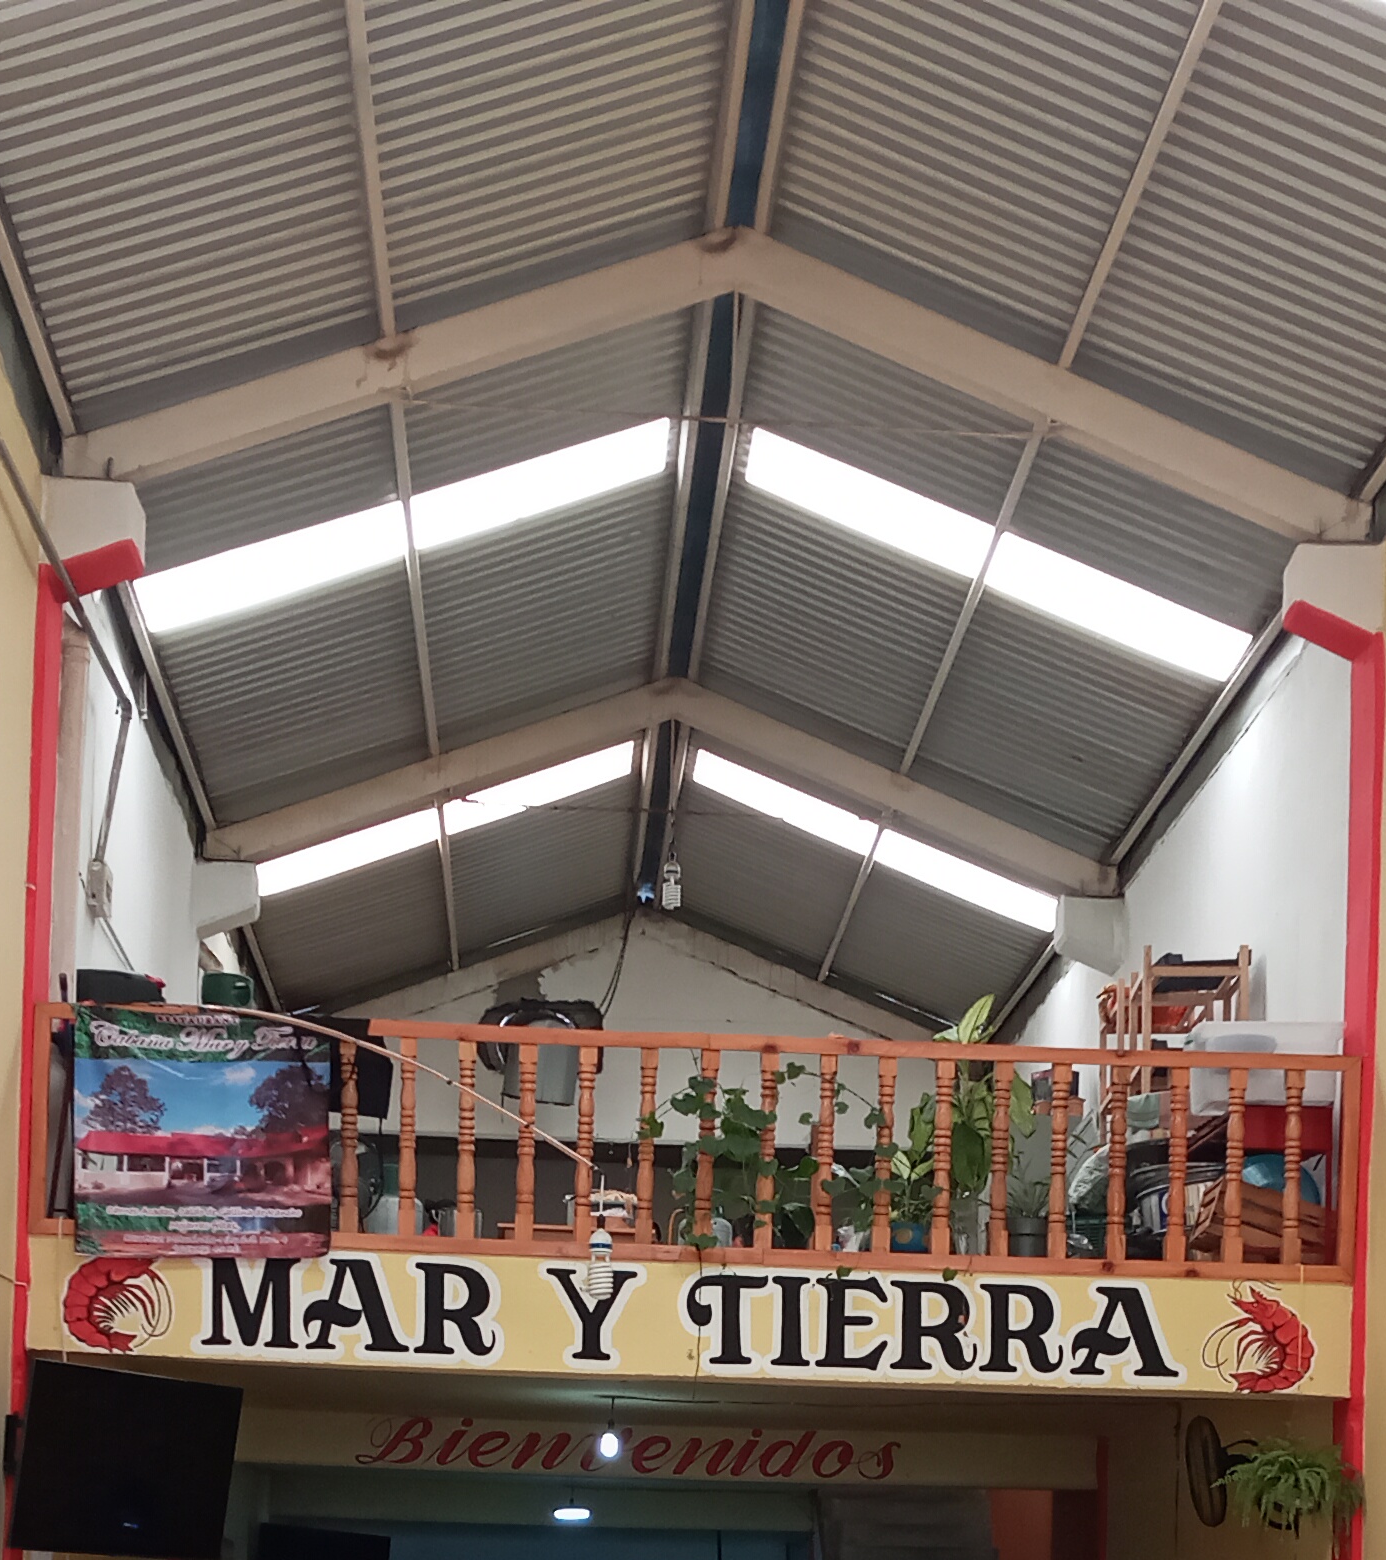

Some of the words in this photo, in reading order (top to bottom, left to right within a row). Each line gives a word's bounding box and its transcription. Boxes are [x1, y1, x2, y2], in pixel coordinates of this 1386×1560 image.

[251, 1026, 318, 1050] Tiera
[200, 1257, 497, 1357] MAR
[545, 1266, 638, 1362] Y
[687, 1274, 1180, 1379] TIERRA
[355, 1416, 902, 1482] Bienvenidos
